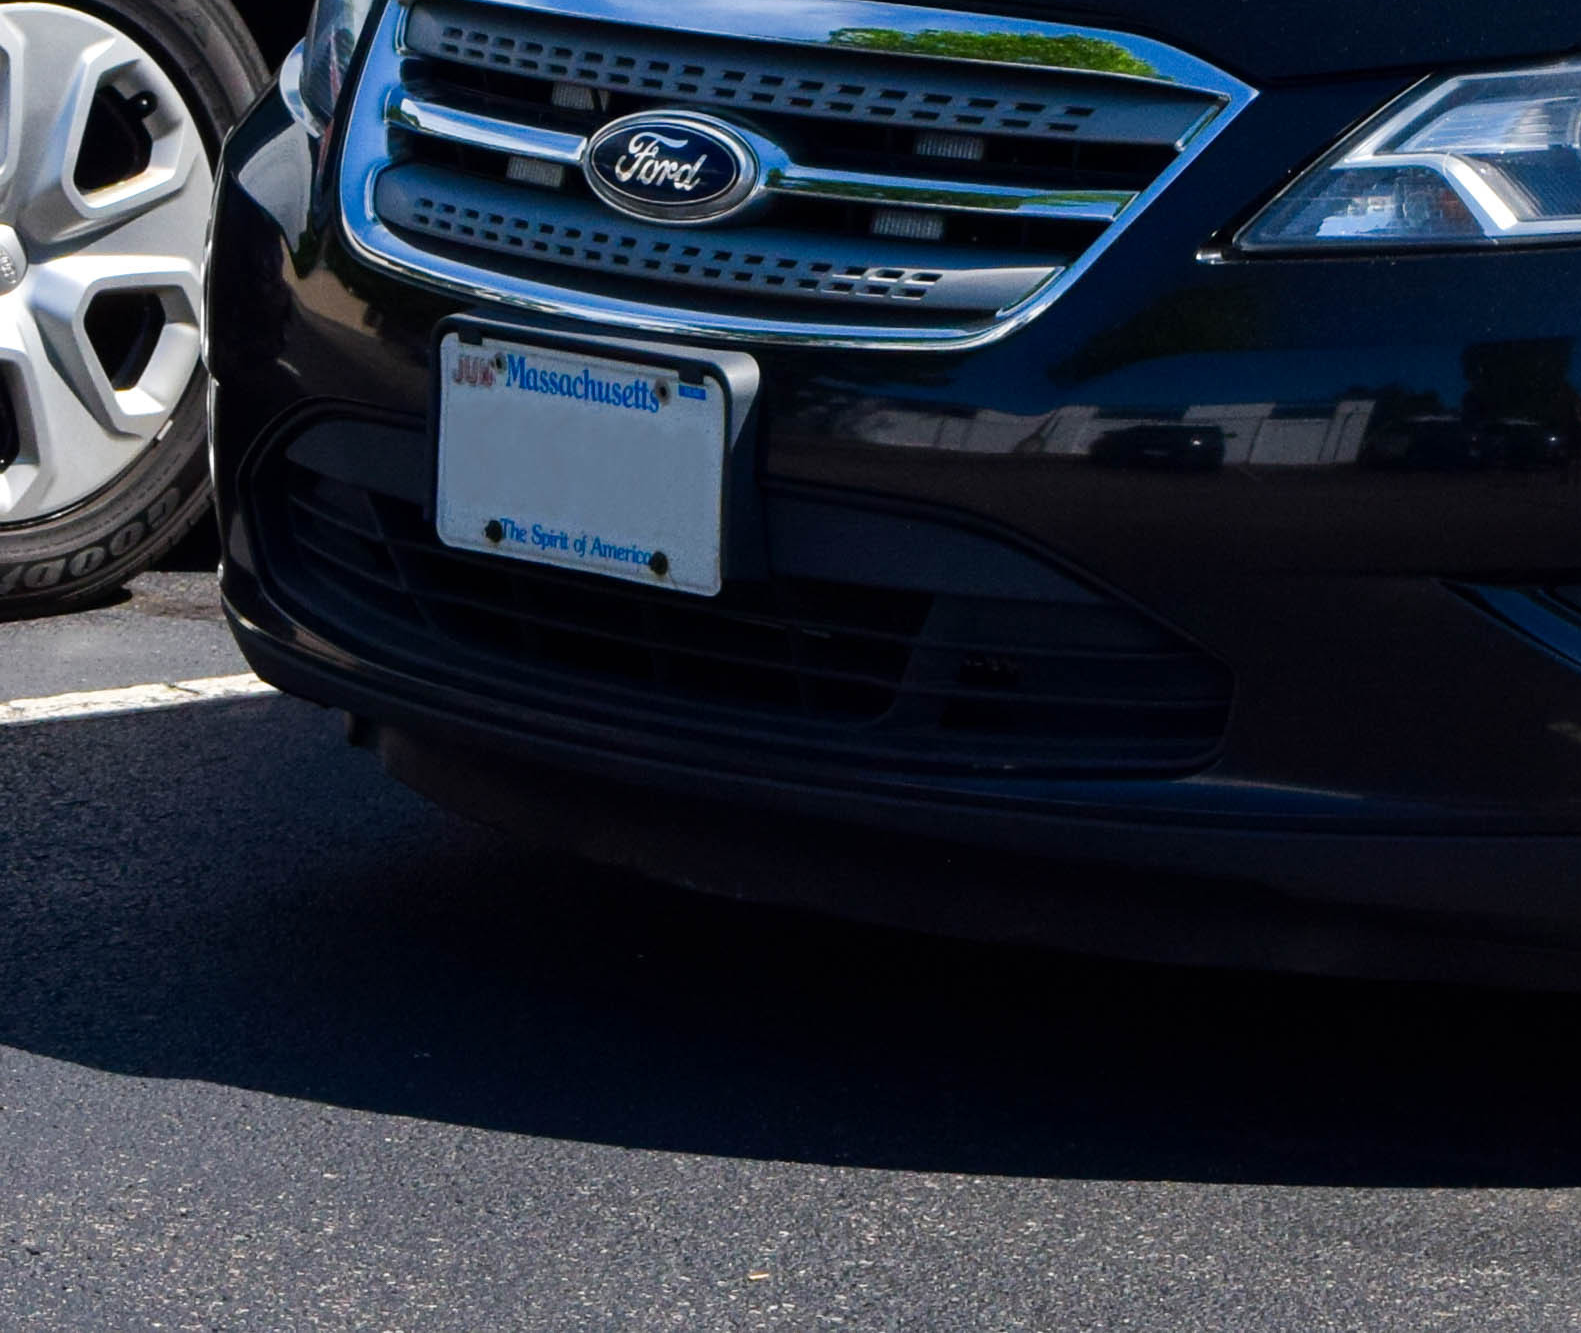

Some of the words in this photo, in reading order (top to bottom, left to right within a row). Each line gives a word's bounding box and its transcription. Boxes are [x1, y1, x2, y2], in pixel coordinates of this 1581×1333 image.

[614, 131, 708, 192] Ford
[505, 353, 660, 413] Massachusetts
[501, 518, 527, 543] The
[531, 524, 569, 551] Spirit
[573, 534, 588, 557] of
[590, 536, 652, 566] America
